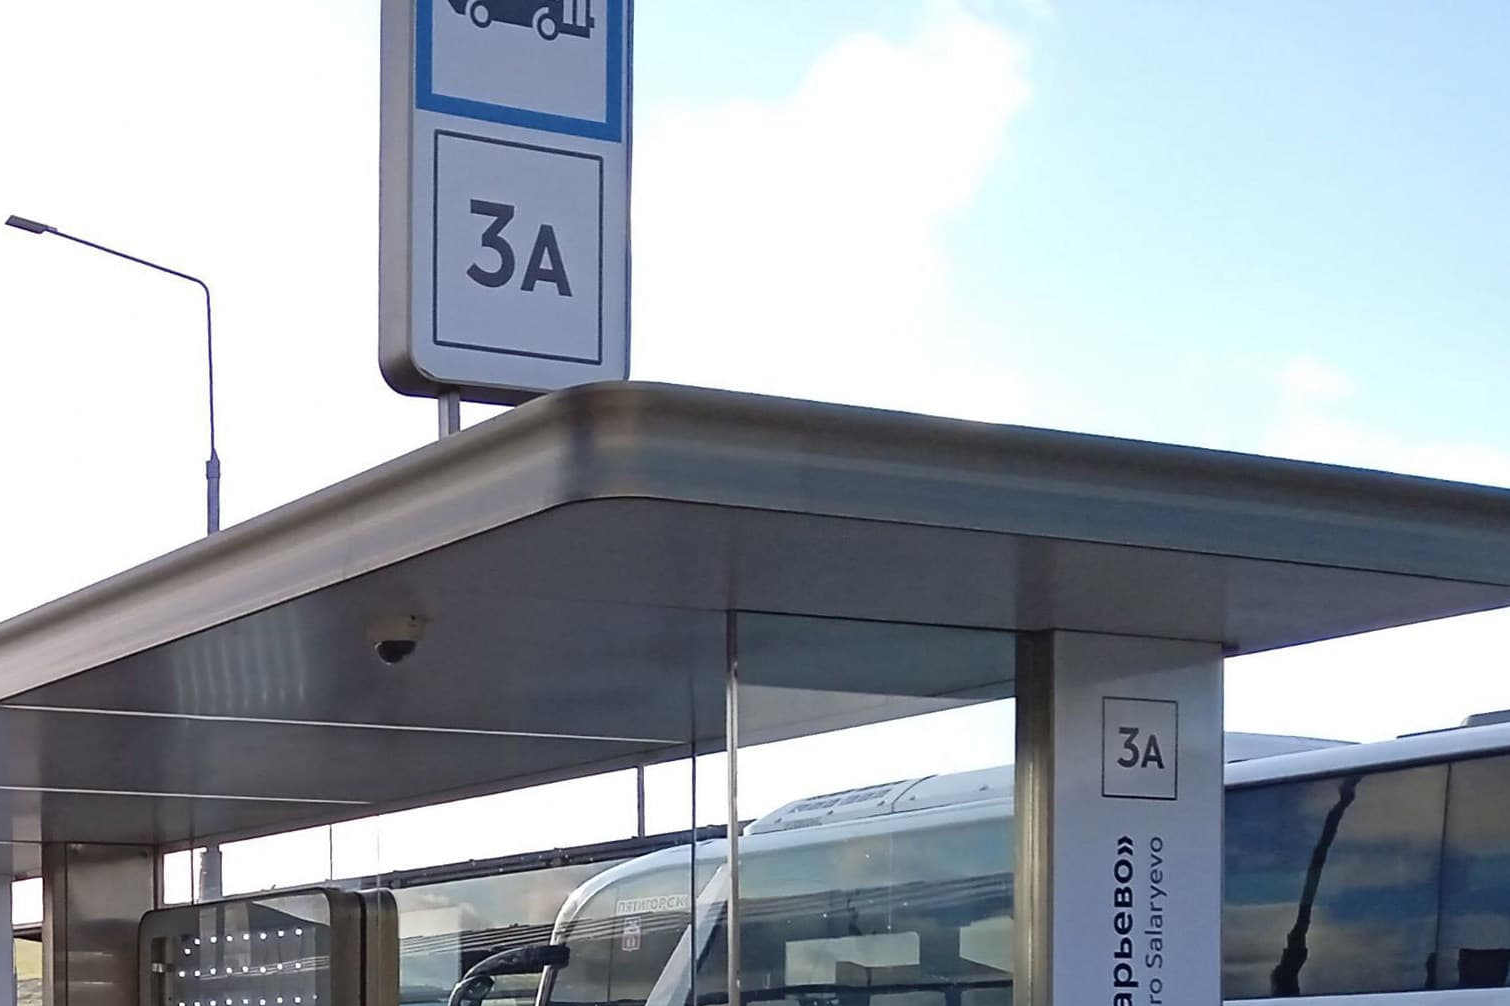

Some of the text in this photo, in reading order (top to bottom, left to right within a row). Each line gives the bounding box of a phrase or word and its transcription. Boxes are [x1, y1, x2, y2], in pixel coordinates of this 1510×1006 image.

[466, 198, 573, 297] 3А
[1117, 726, 1165, 770] 3А
[1144, 836, 1168, 968] Salaryevo
